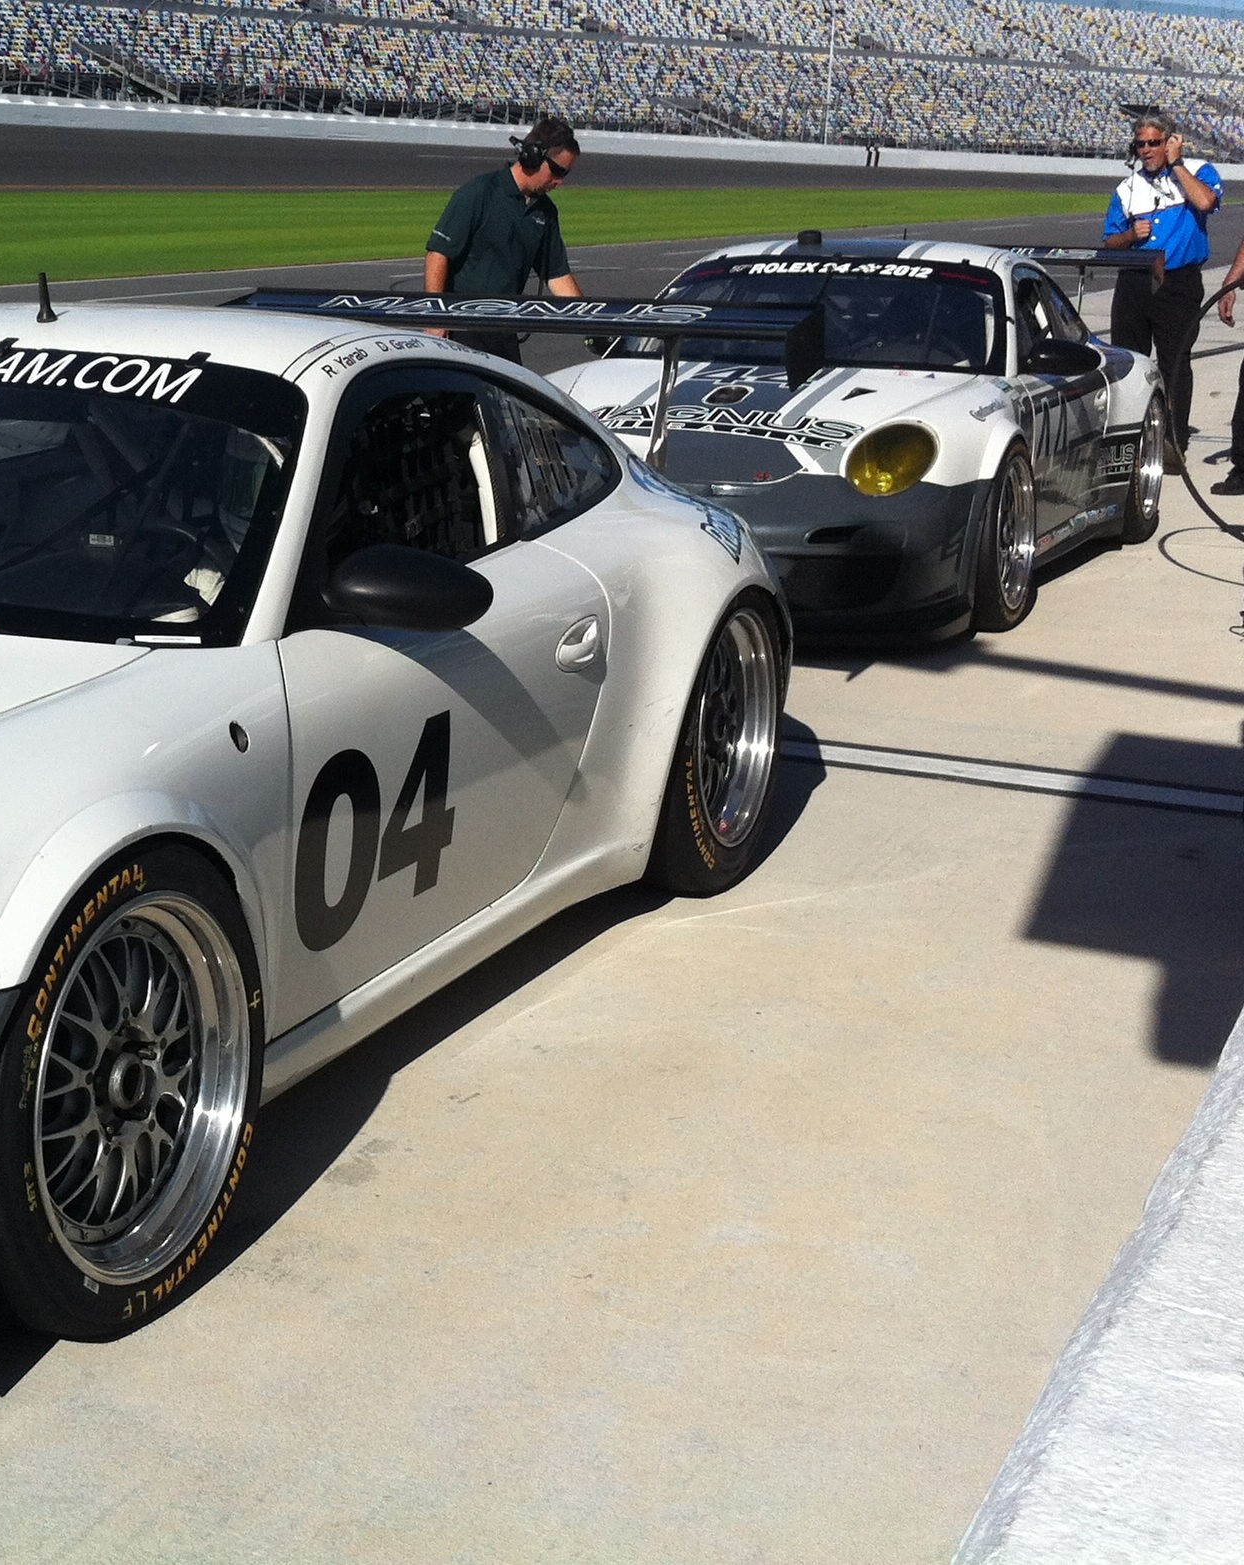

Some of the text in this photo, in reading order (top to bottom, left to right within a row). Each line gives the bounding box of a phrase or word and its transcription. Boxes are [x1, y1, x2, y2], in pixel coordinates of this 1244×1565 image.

[319, 294, 713, 324] MAGNUS
[748, 261, 820, 275] ROLEX
[879, 263, 934, 279] 2012
[333, 346, 369, 370] Yarab
[294, 709, 456, 953] 04
[26, 863, 145, 1042] CONTINENTAL
[152, 1121, 255, 1302] CONTINENTAL
